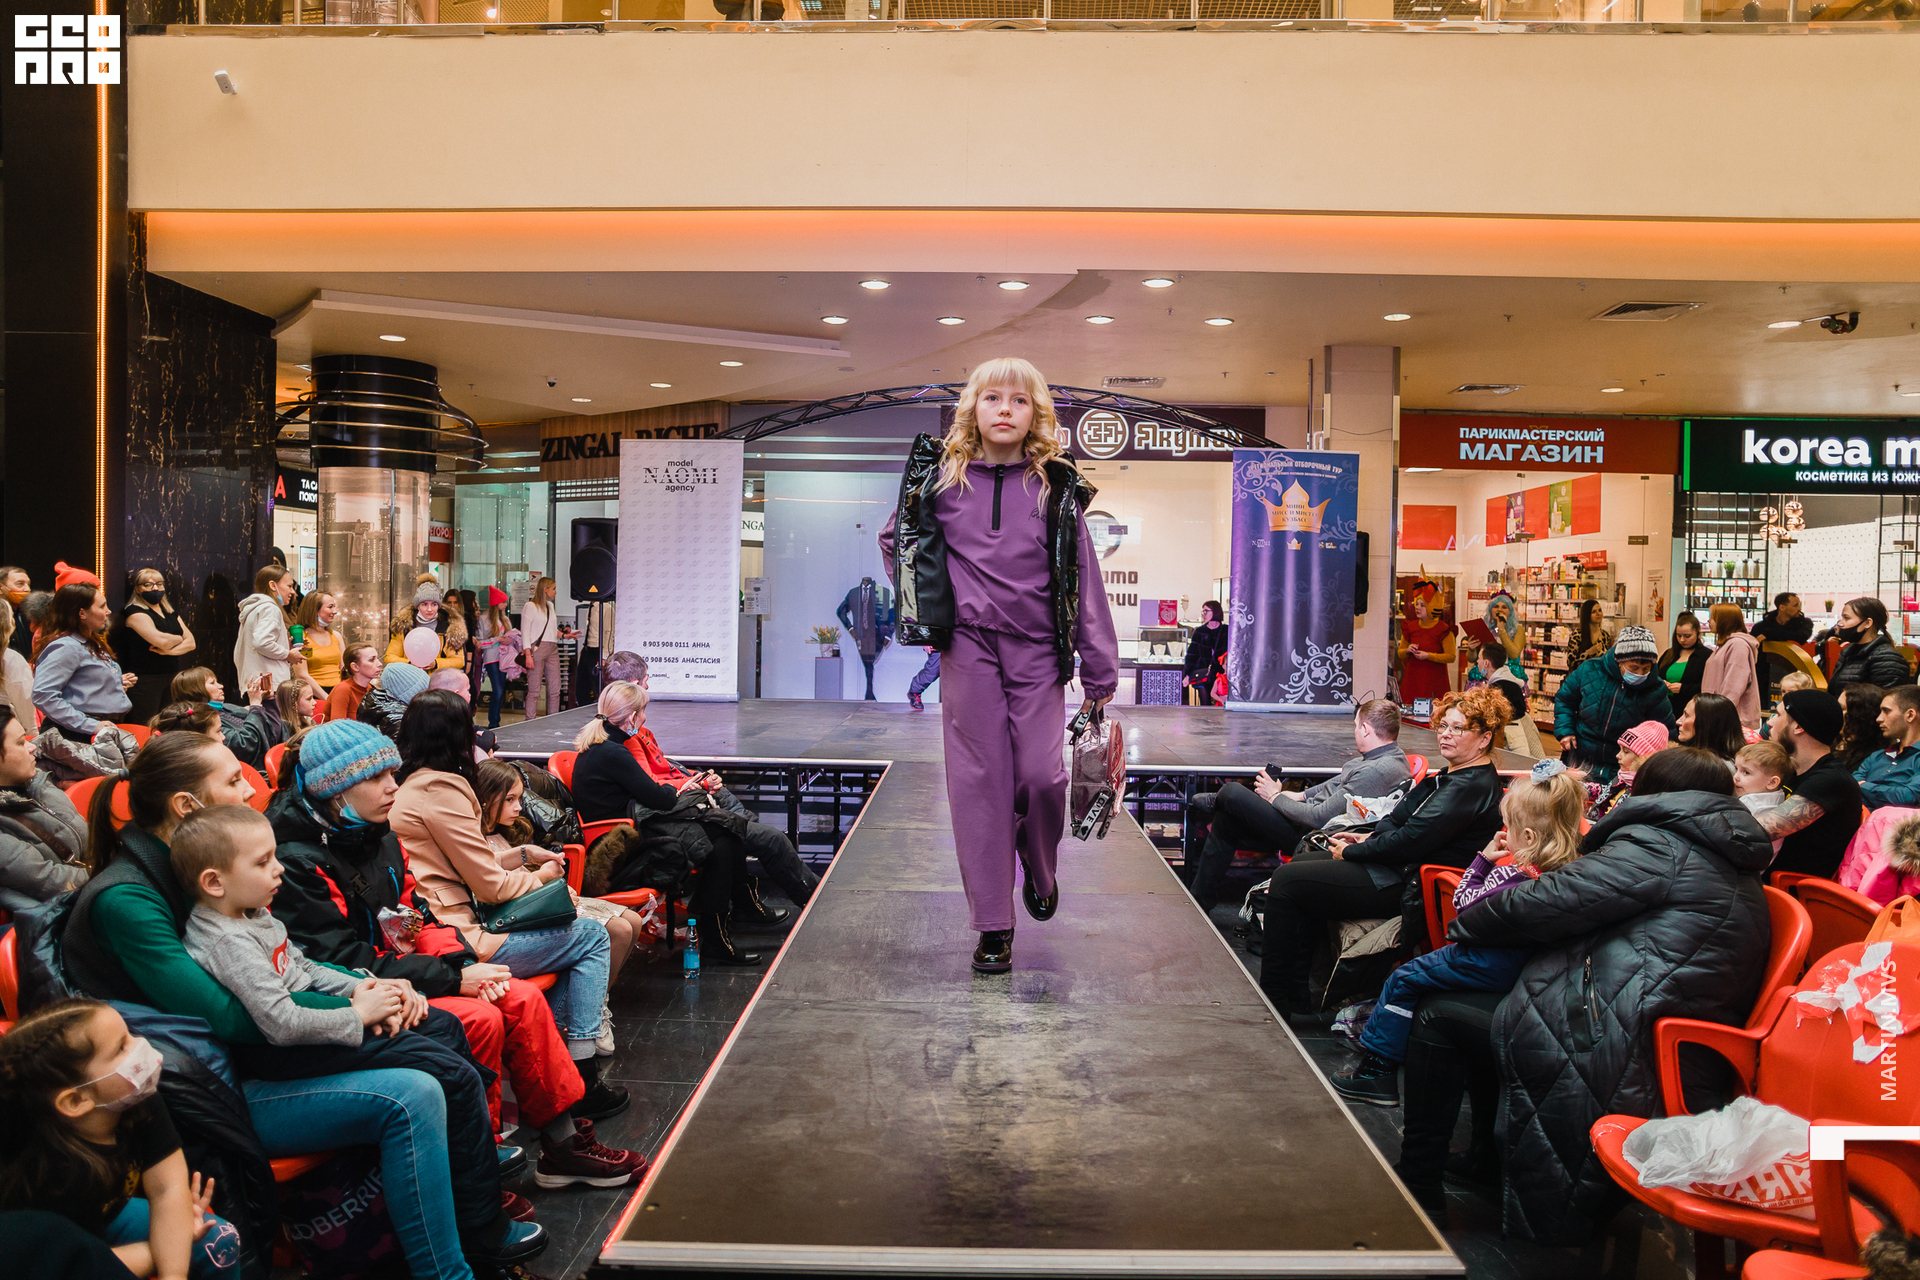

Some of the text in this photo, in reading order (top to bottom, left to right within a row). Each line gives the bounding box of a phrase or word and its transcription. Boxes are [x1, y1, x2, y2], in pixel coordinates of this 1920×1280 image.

[1459, 427, 1606, 443] ПАРИКМАСТЕРСКИЙ
[1459, 442, 1605, 464] МАГАЗИН
[1743, 428, 1872, 467] korea
[667, 459, 694, 467] model
[1294, 461, 1331, 472] ОТБОРОЧНЫЙ
[1332, 465, 1343, 475] ТУР
[642, 467, 719, 484] NAOMI
[1795, 470, 1868, 483] косметика
[1871, 471, 1889, 483] из
[300, 478, 310, 490] ТА
[665, 484, 696, 493] agency
[681, 657, 721, 665] АНАСТАСИЯ
